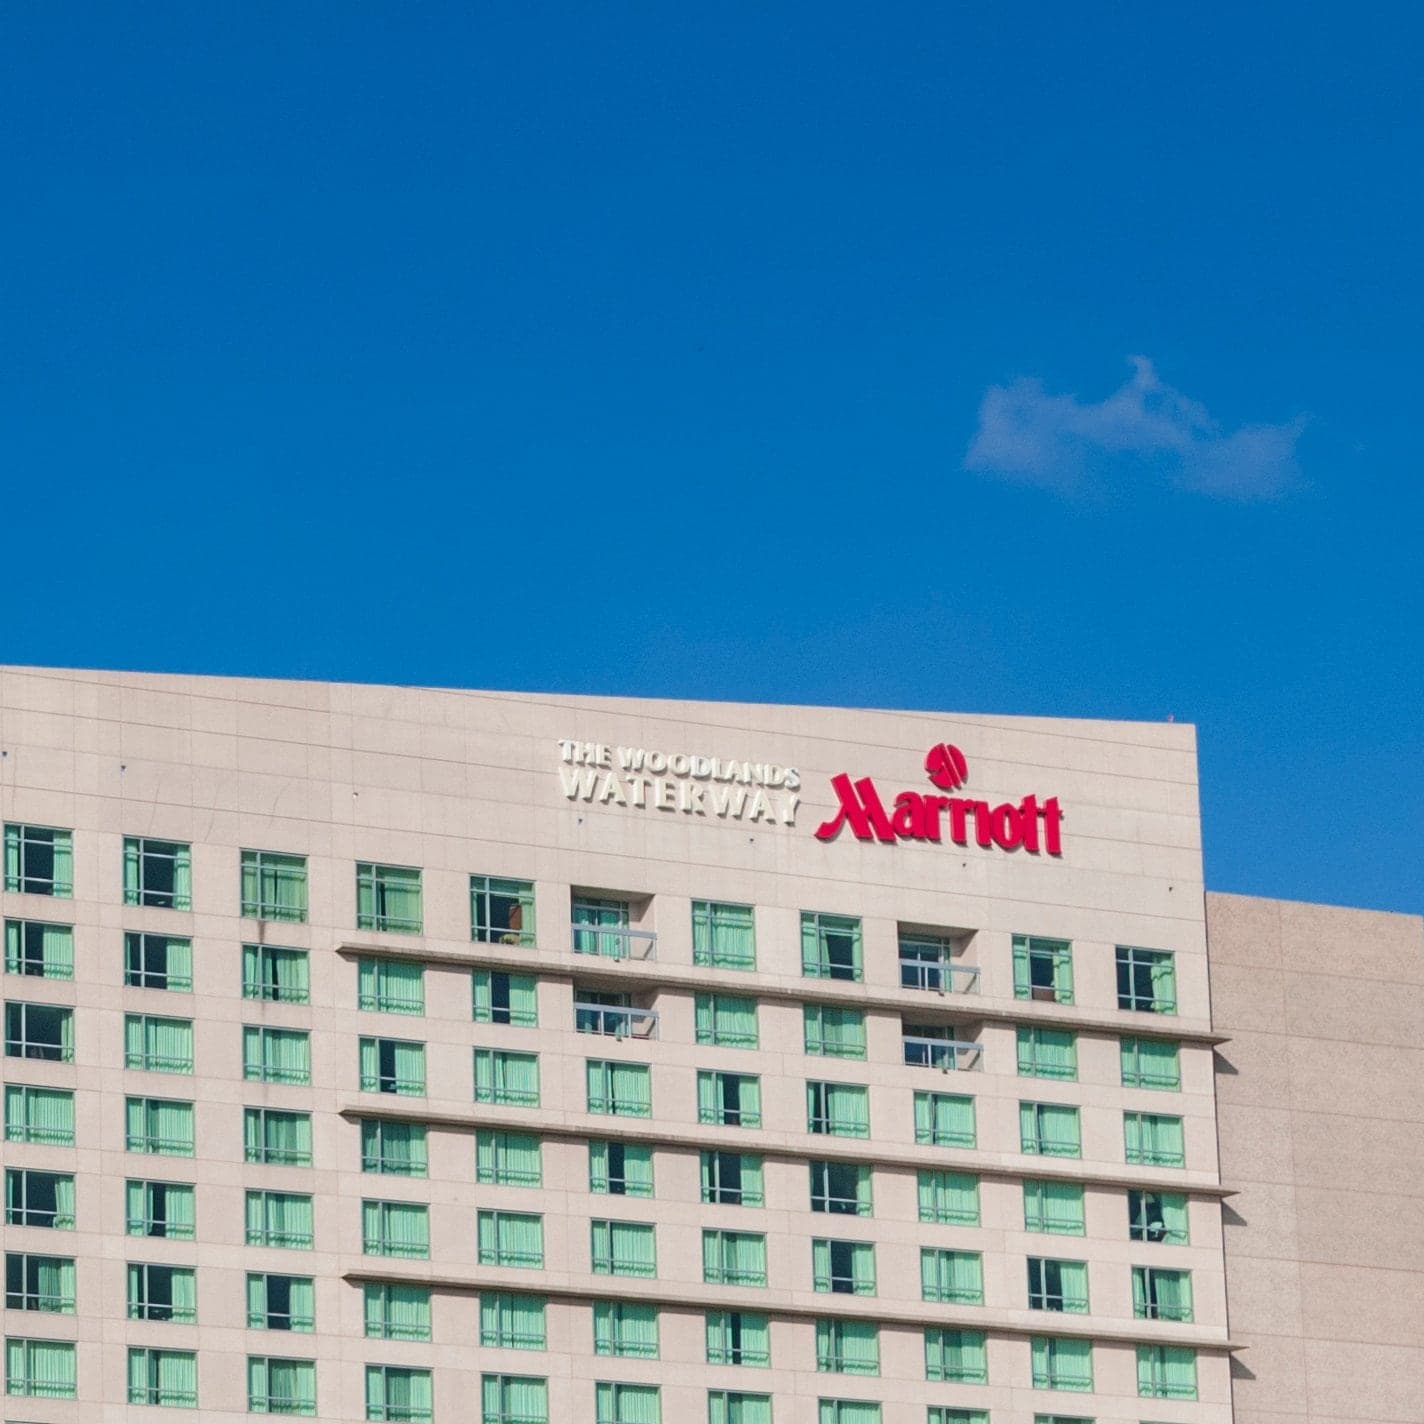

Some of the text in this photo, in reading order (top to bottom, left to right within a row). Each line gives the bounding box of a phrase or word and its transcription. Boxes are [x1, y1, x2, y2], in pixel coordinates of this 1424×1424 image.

[558, 739, 800, 789] THE WOODLANDS
[559, 766, 800, 825] WATERWAY
[814, 773, 1064, 857] Marriott
